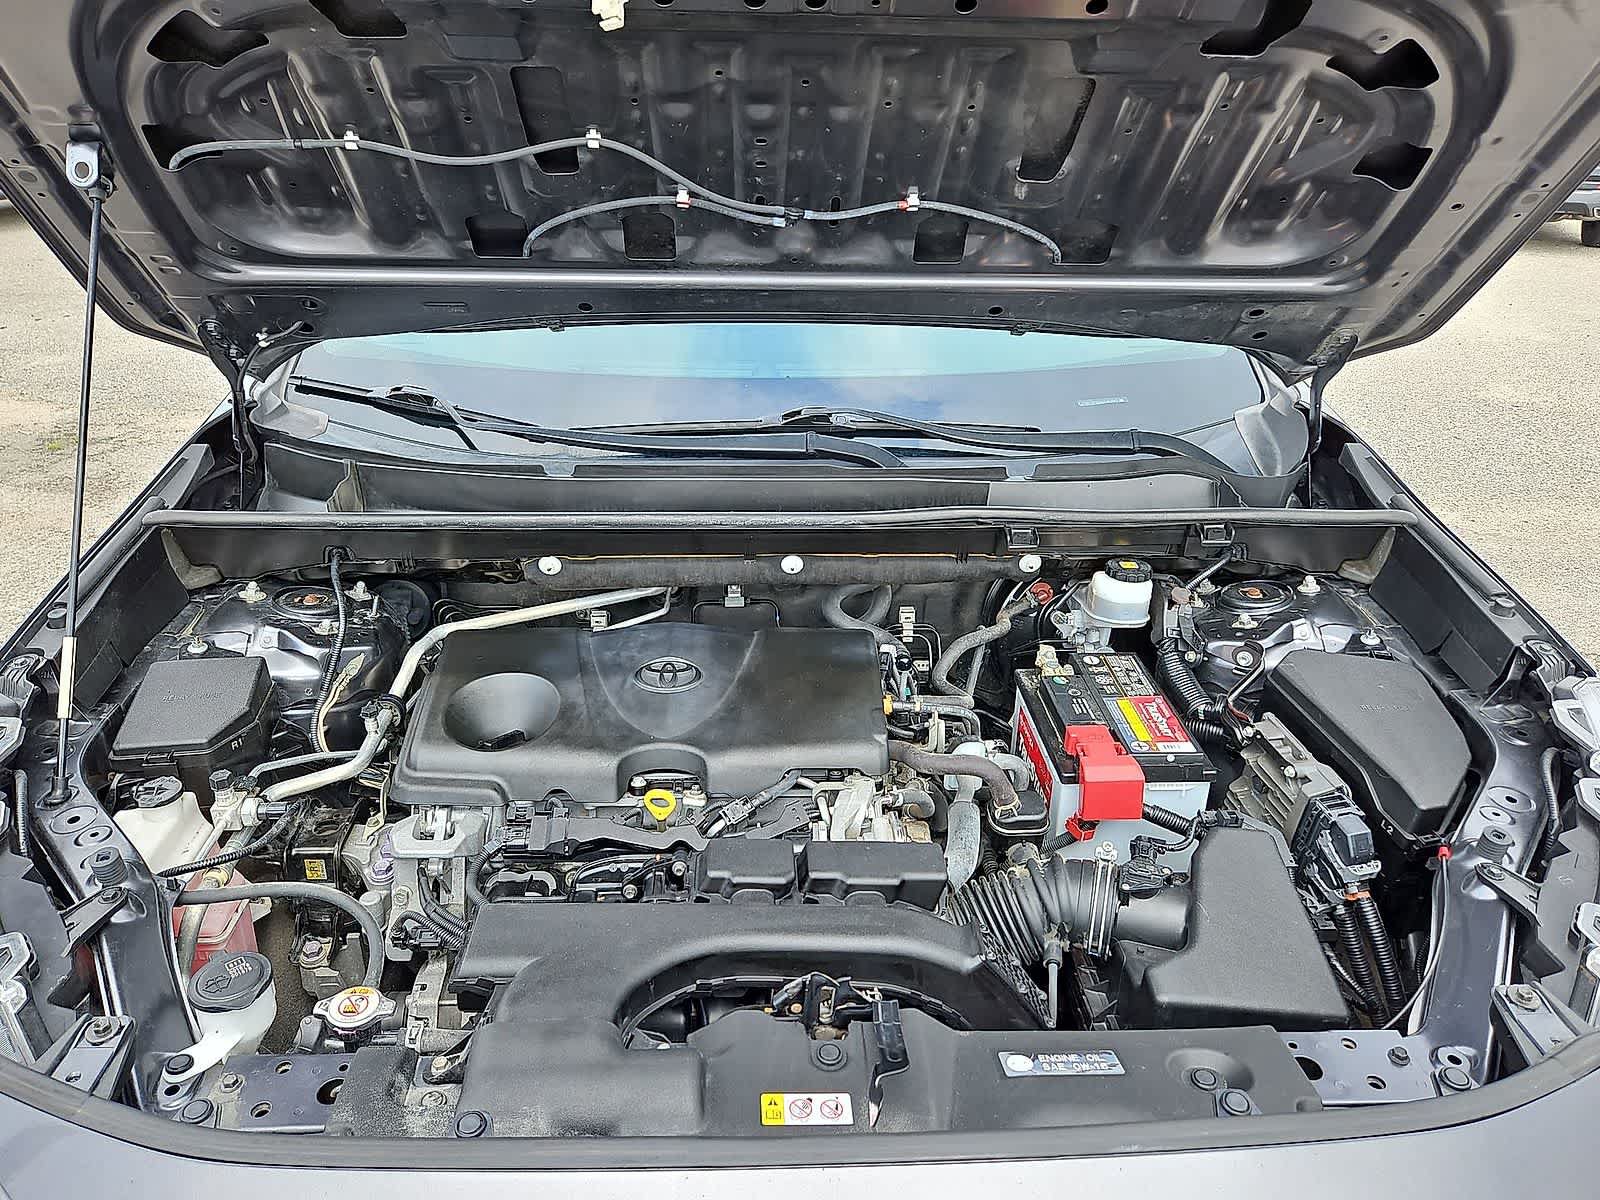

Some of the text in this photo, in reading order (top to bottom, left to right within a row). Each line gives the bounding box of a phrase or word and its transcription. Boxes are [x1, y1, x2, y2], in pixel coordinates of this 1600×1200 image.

[1380, 819, 1393, 836] L2
[1037, 1053, 1106, 1063] ENGINE OIL
[1042, 1062, 1065, 1071] SAE
